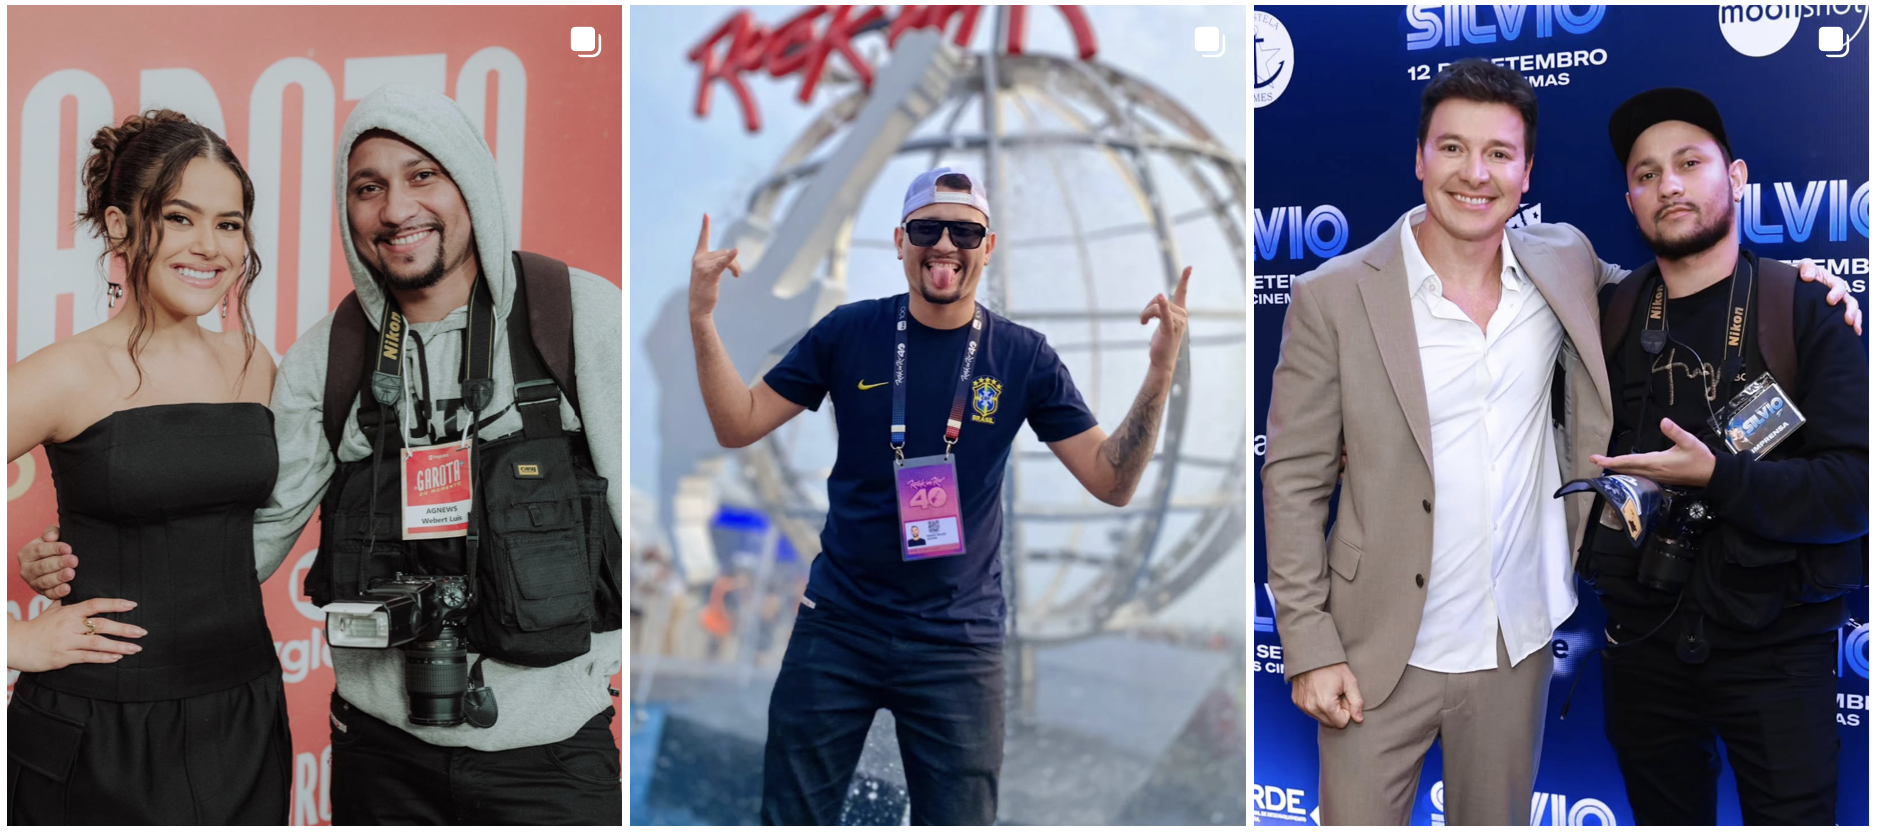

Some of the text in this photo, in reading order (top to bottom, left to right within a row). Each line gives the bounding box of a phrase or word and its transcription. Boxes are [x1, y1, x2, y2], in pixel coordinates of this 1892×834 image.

[1406, 5, 1607, 50] SILVIO
[1408, 65, 1431, 81] 12
[1650, 284, 1664, 319] Nikon
[383, 311, 402, 360] Nikon
[1728, 307, 1744, 346] Nikon
[1742, 397, 1783, 435] SILVIO
[1751, 421, 1789, 454] IMPRENSA
[416, 459, 461, 492] GAROTA
[426, 505, 458, 514] AGNEWS
[909, 486, 947, 510] 40
